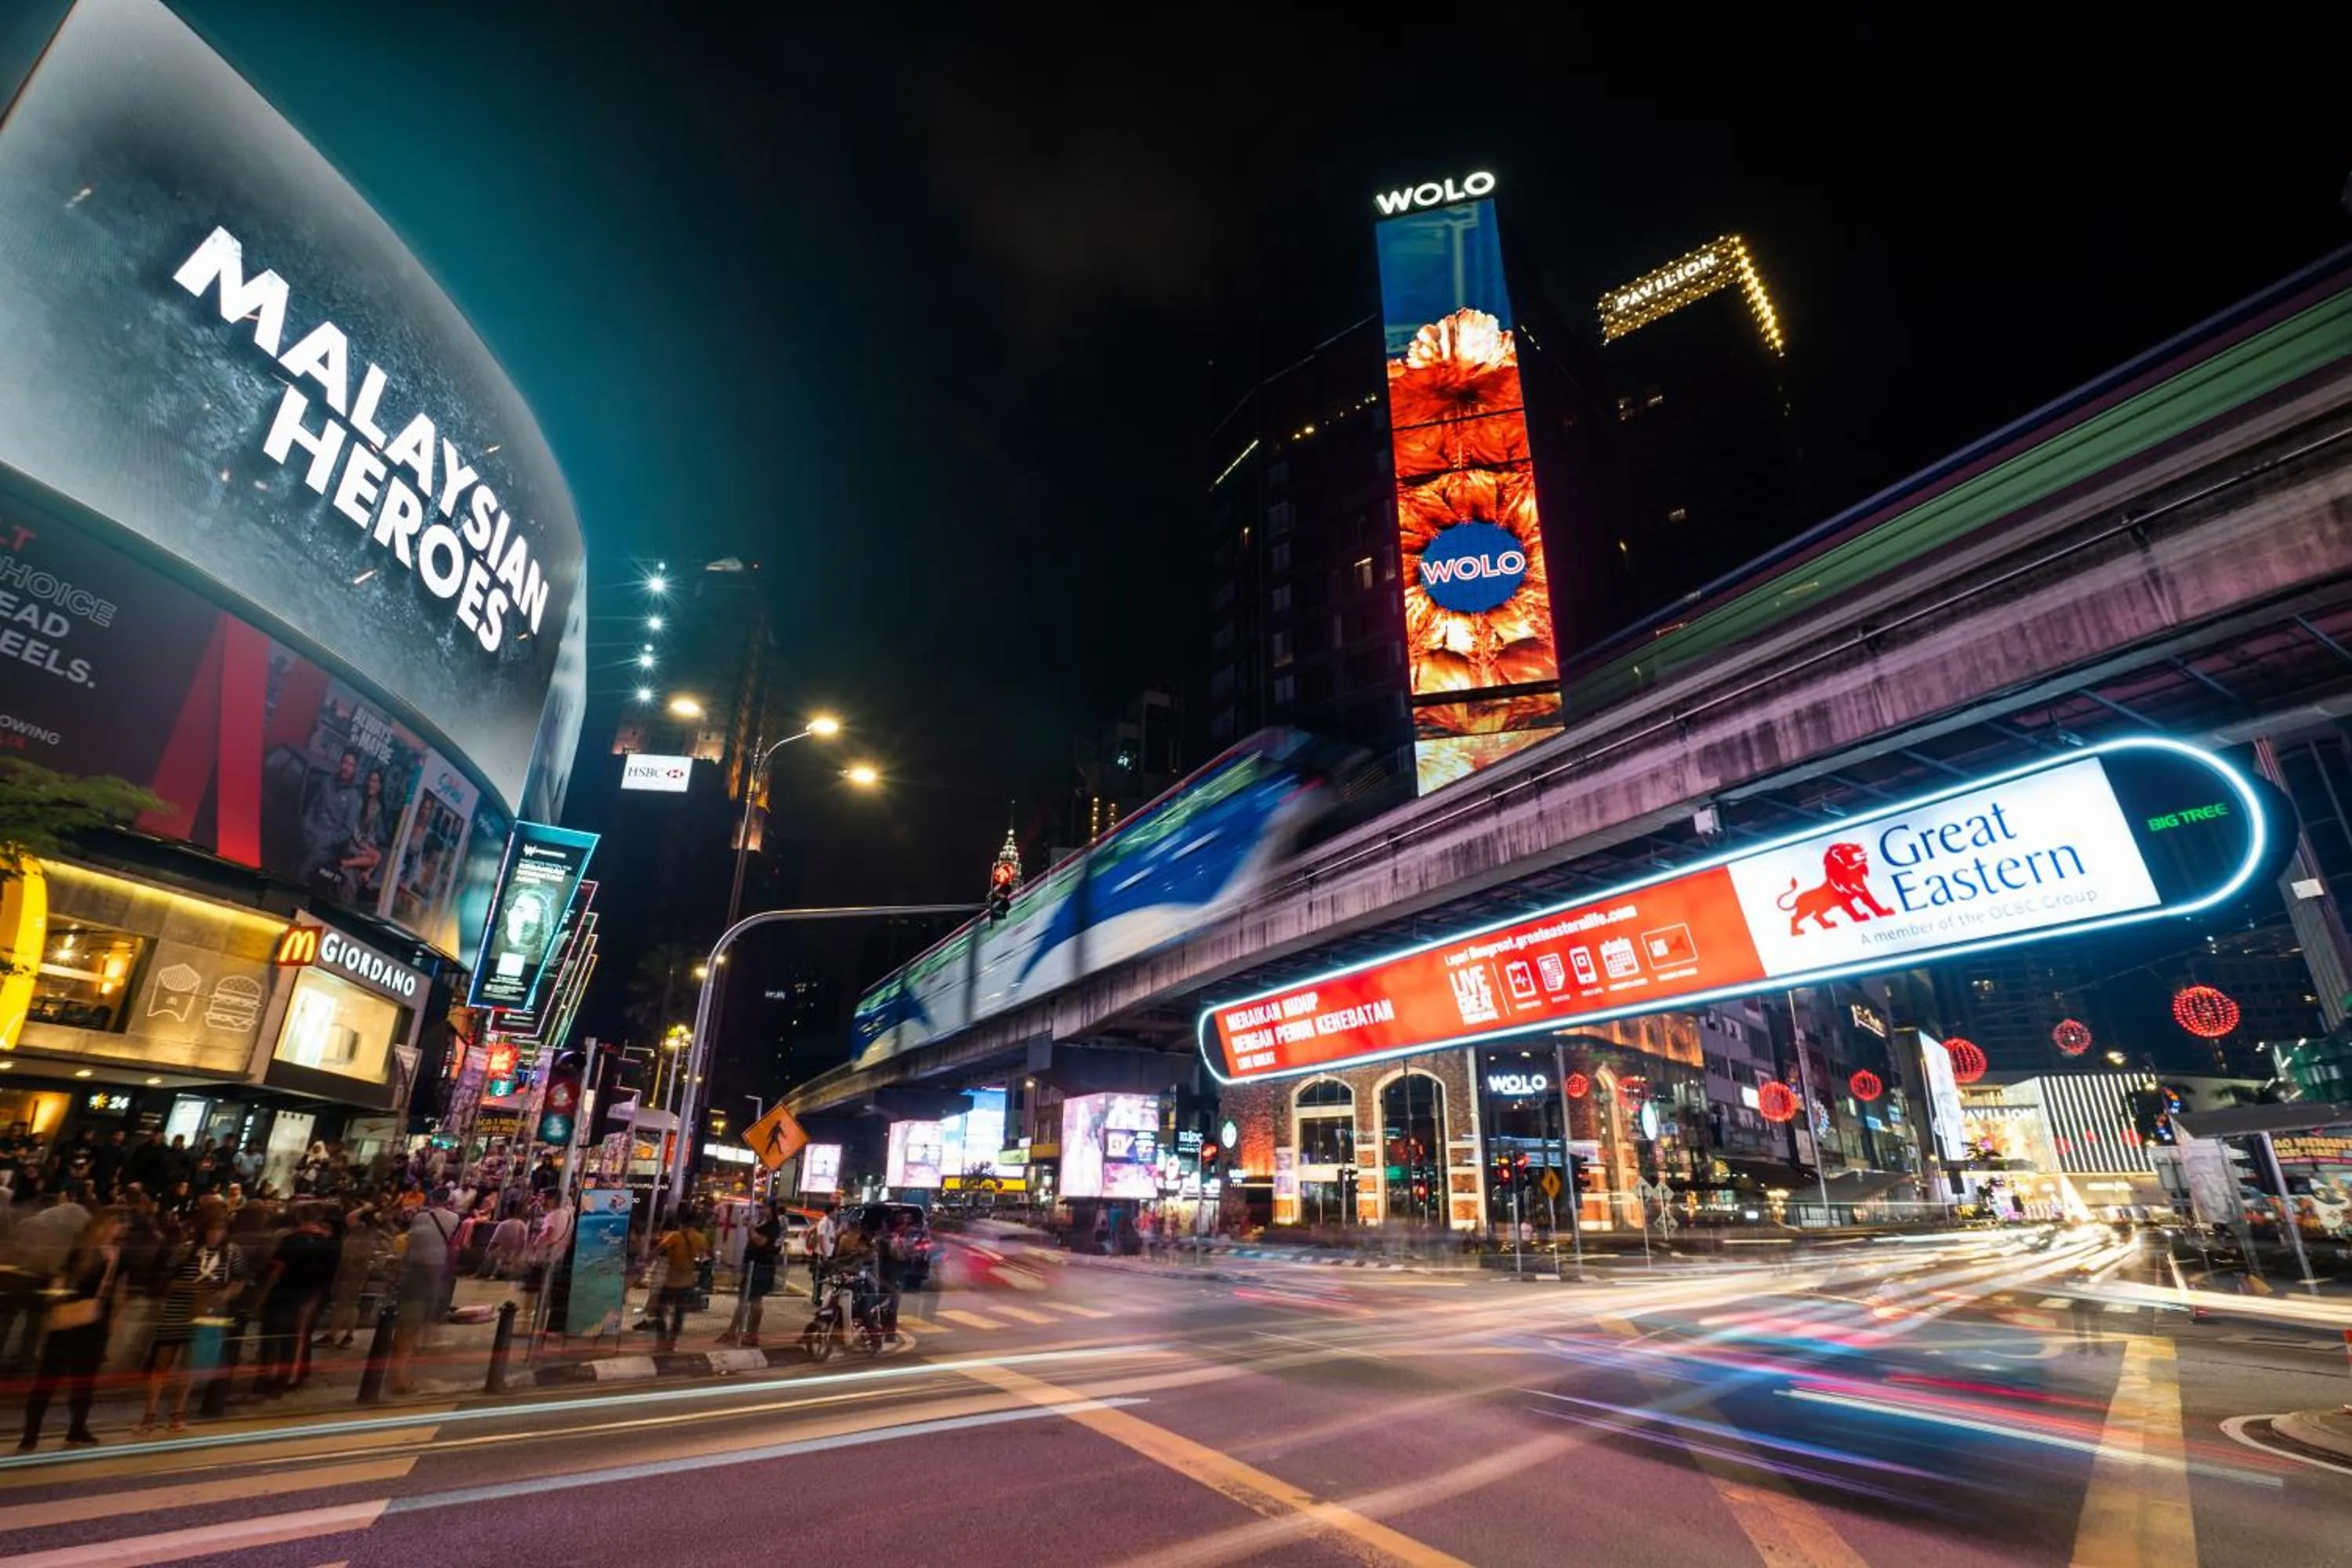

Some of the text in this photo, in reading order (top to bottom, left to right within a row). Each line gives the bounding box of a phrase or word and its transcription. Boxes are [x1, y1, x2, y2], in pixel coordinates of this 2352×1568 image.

[1376, 171, 1495, 215] WOLO
[1616, 253, 1717, 311] PAVILION
[173, 226, 548, 635] MALAYSIAN
[263, 384, 510, 652] HEROES
[0, 556, 118, 628] HOICE
[1421, 551, 1526, 584] WOLO
[1879, 803, 2017, 869] Great
[2147, 803, 2229, 832] BIG TREE
[1891, 844, 2085, 913] Eastern
[1860, 889, 2098, 946] A member of the OCBC Group
[320, 932, 416, 996] GIORDANO
[1450, 964, 1486, 996] LIVE
[1316, 998, 1396, 1035] KEHEBATAN
[1488, 1074, 1547, 1093] WOLO
